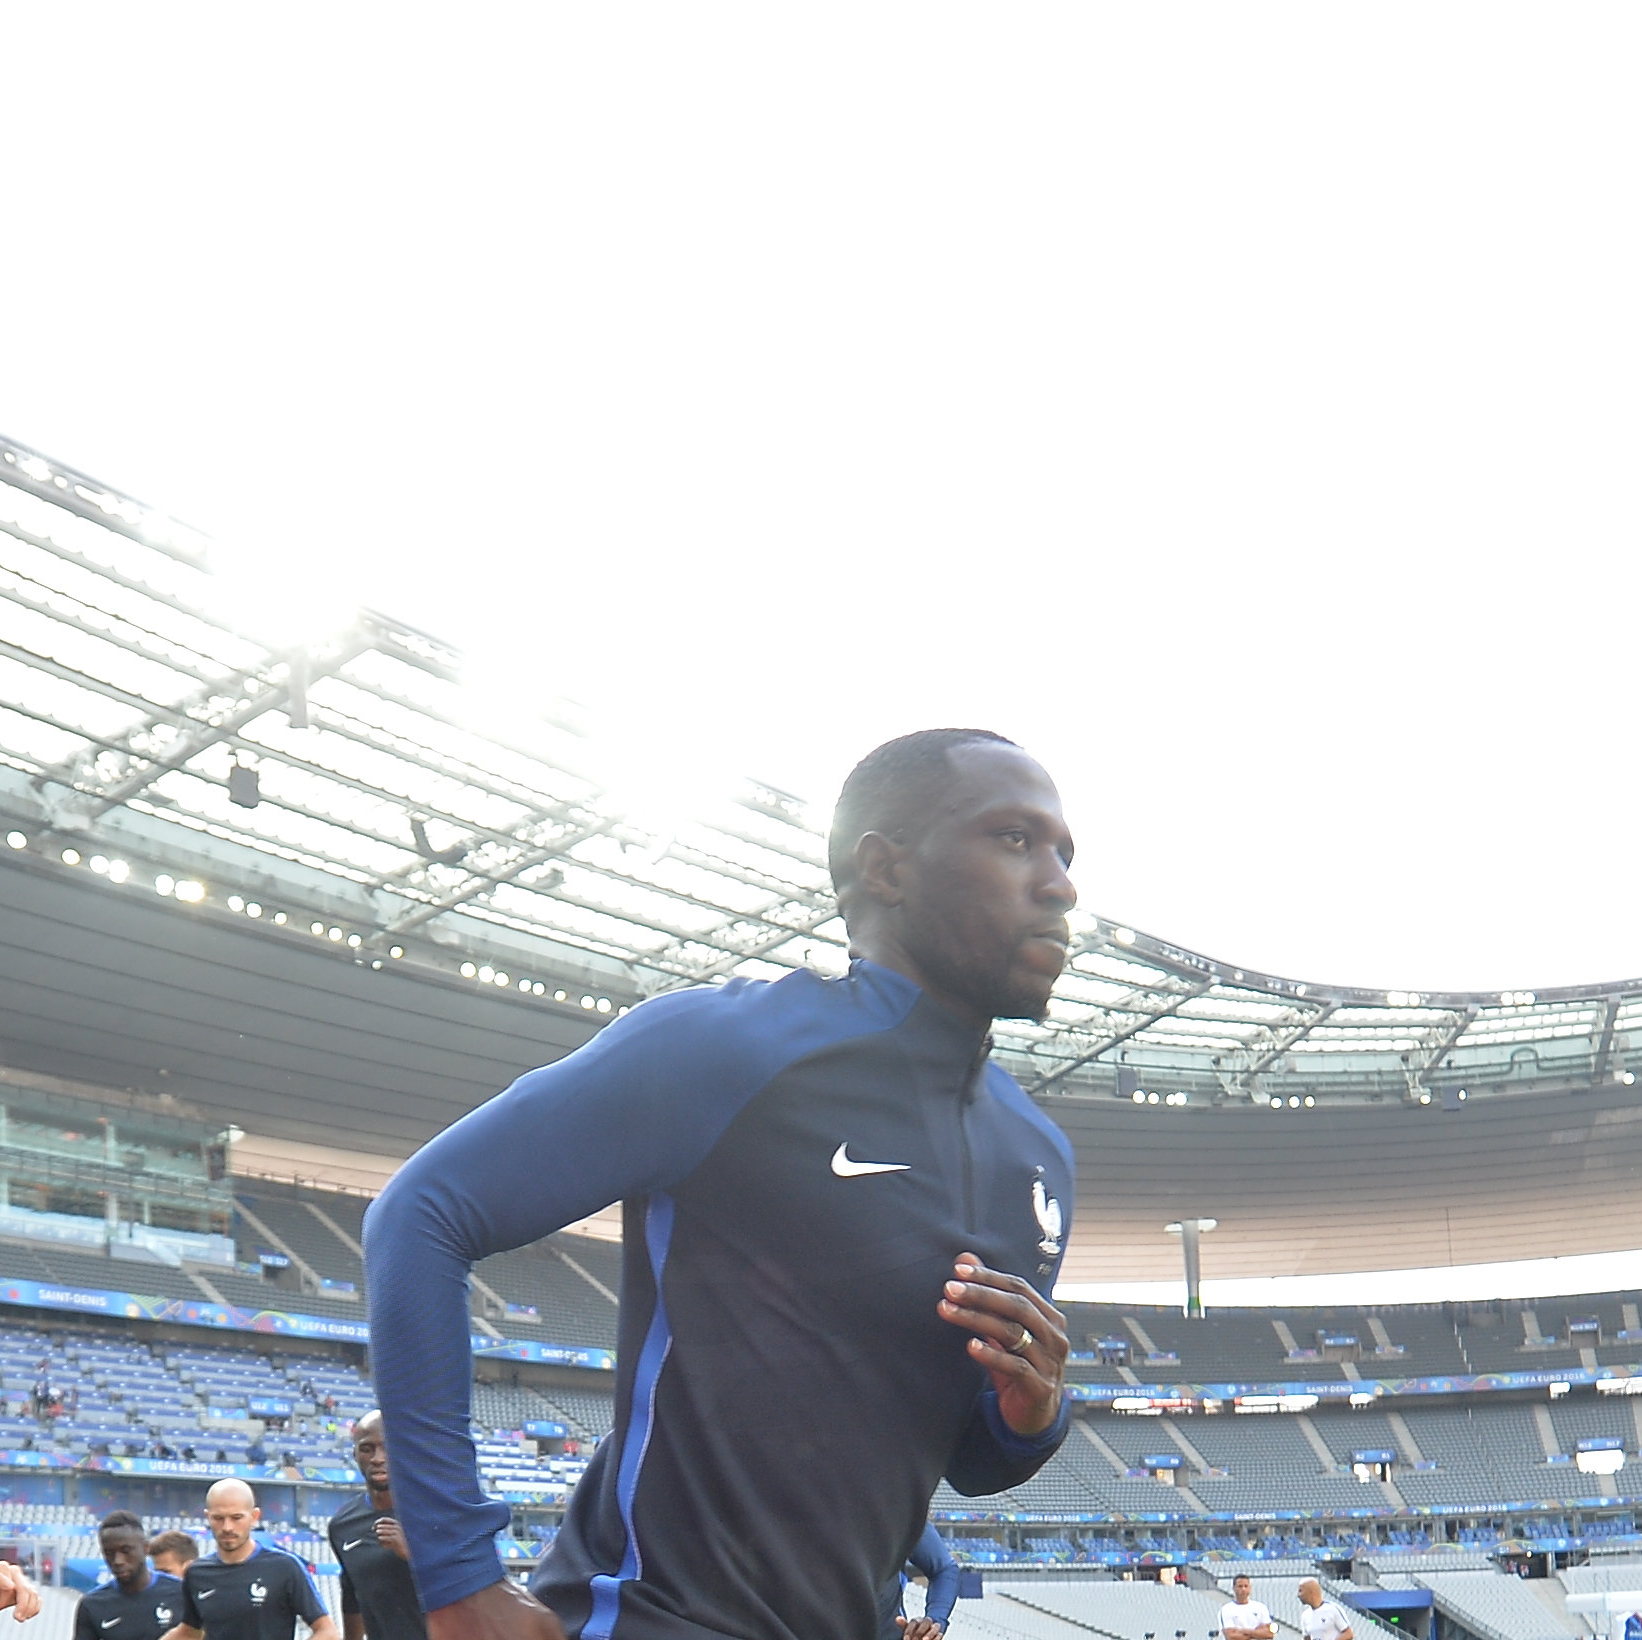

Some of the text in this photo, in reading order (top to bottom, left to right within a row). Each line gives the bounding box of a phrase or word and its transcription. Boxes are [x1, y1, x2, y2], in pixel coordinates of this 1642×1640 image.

[38, 1288, 107, 1307] SAINT-DENIS
[300, 1320, 369, 1337] UEFA EURO 20
[1513, 1372, 1586, 1384] UEFA EURO 2016
[1091, 1388, 1156, 1397] UEFA EURO 2016
[1306, 1384, 1353, 1394] SAINT-DENIS
[251, 1402, 268, 1412] U12
[149, 1460, 236, 1475] UEFA EURO 2016
[1442, 1506, 1464, 1514] UEFA
[1488, 1504, 1508, 1512] 2016
[1025, 1514, 1043, 1522] UEFA
[1044, 1514, 1063, 1522] EURO
[1234, 1513, 1276, 1521] SAINT-DENIS
